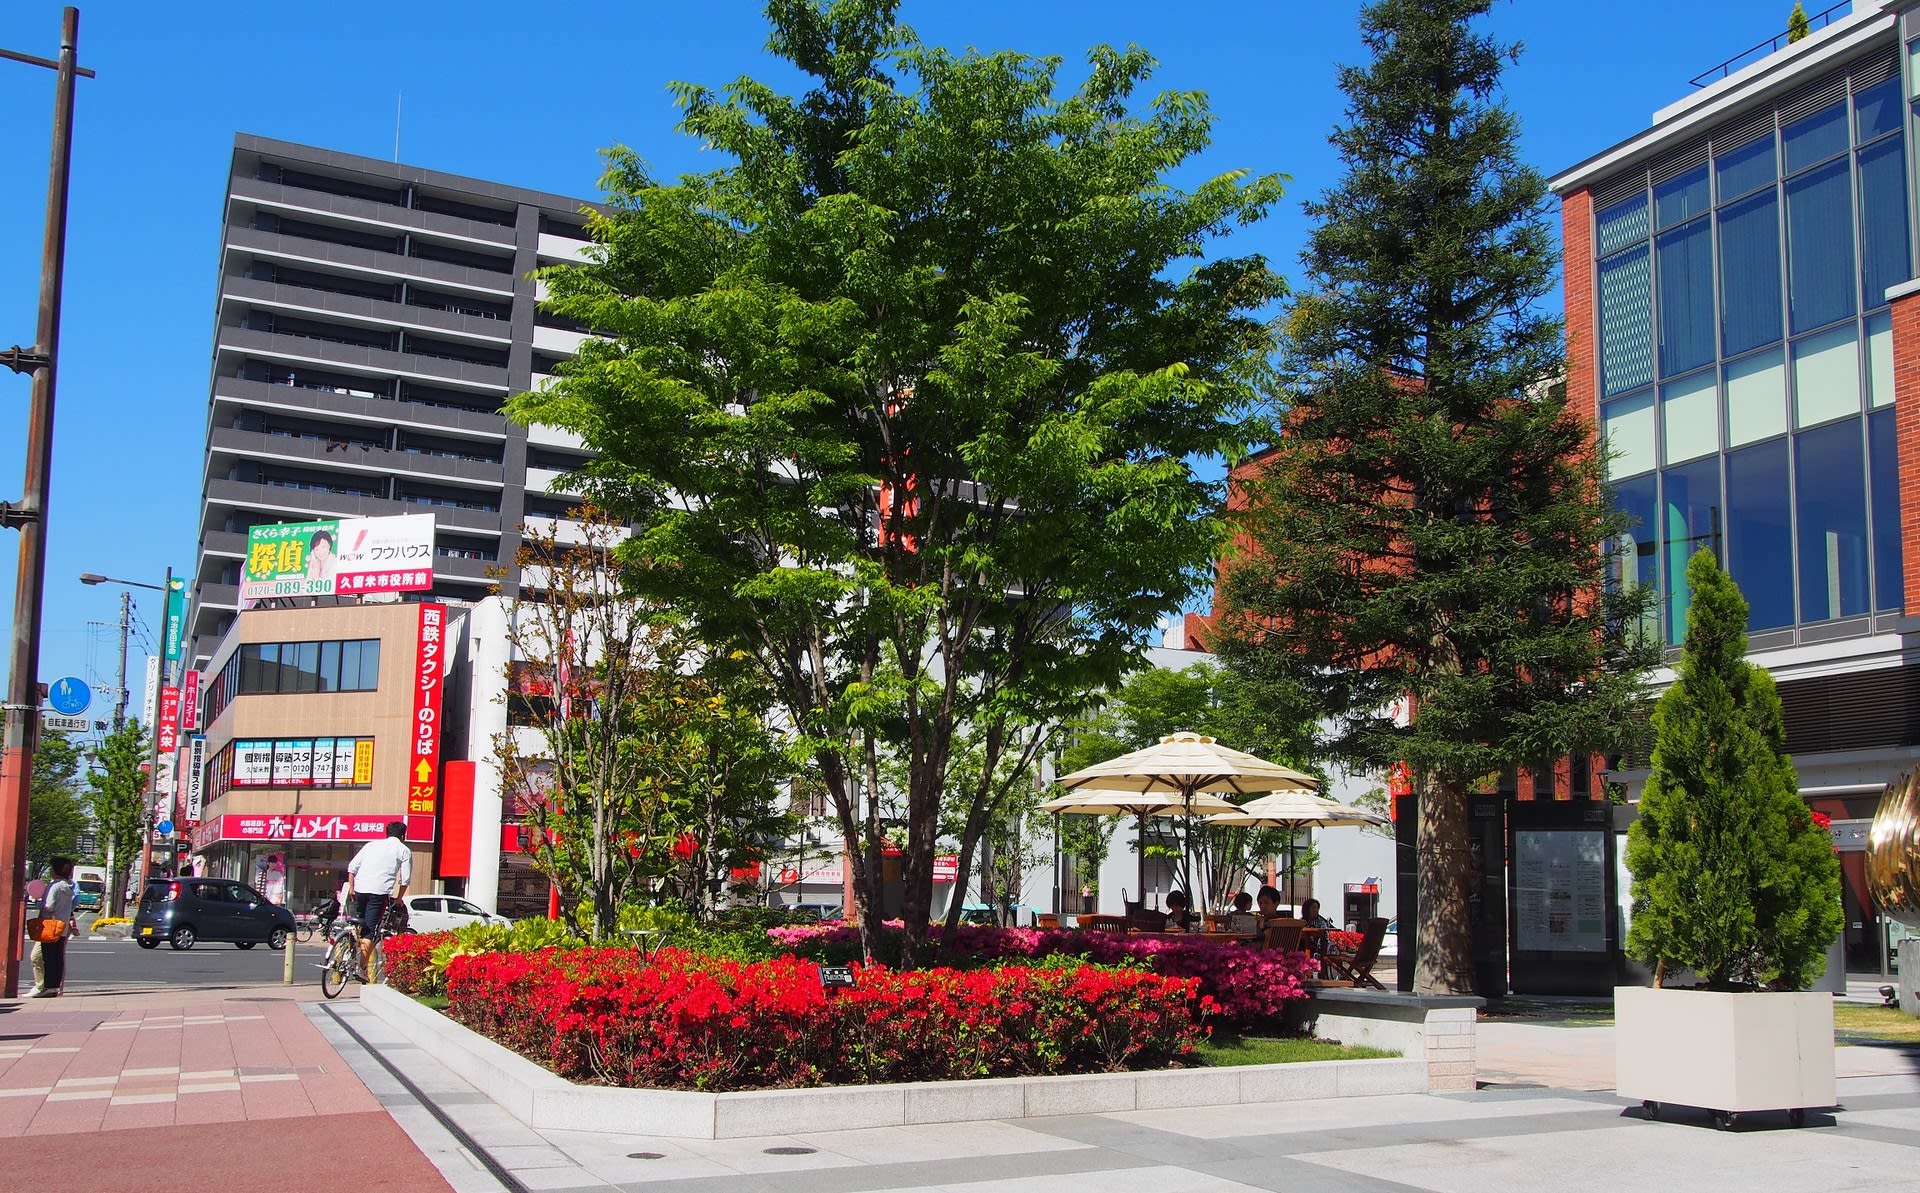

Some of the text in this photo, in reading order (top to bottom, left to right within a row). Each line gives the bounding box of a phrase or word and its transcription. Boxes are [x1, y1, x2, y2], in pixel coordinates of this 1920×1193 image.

[249, 539, 304, 574] 探偵
[371, 545, 431, 560] ワウハウス
[247, 579, 332, 596] 0120-089-390
[340, 573, 427, 589] 久留米市役所前
[417, 609, 440, 755] 西鉄タクシーのりば
[185, 686, 195, 724] ホームメイト
[48, 718, 86, 728] 自転車通行可
[161, 724, 174, 748] 大栄
[245, 752, 352, 763] 個別指導塾スタンダード
[411, 786, 434, 797] スグ
[410, 799, 434, 812] 右側
[268, 816, 348, 838] ホームメイト
[353, 822, 385, 832] 久留米店
[177, 843, 188, 852] P
